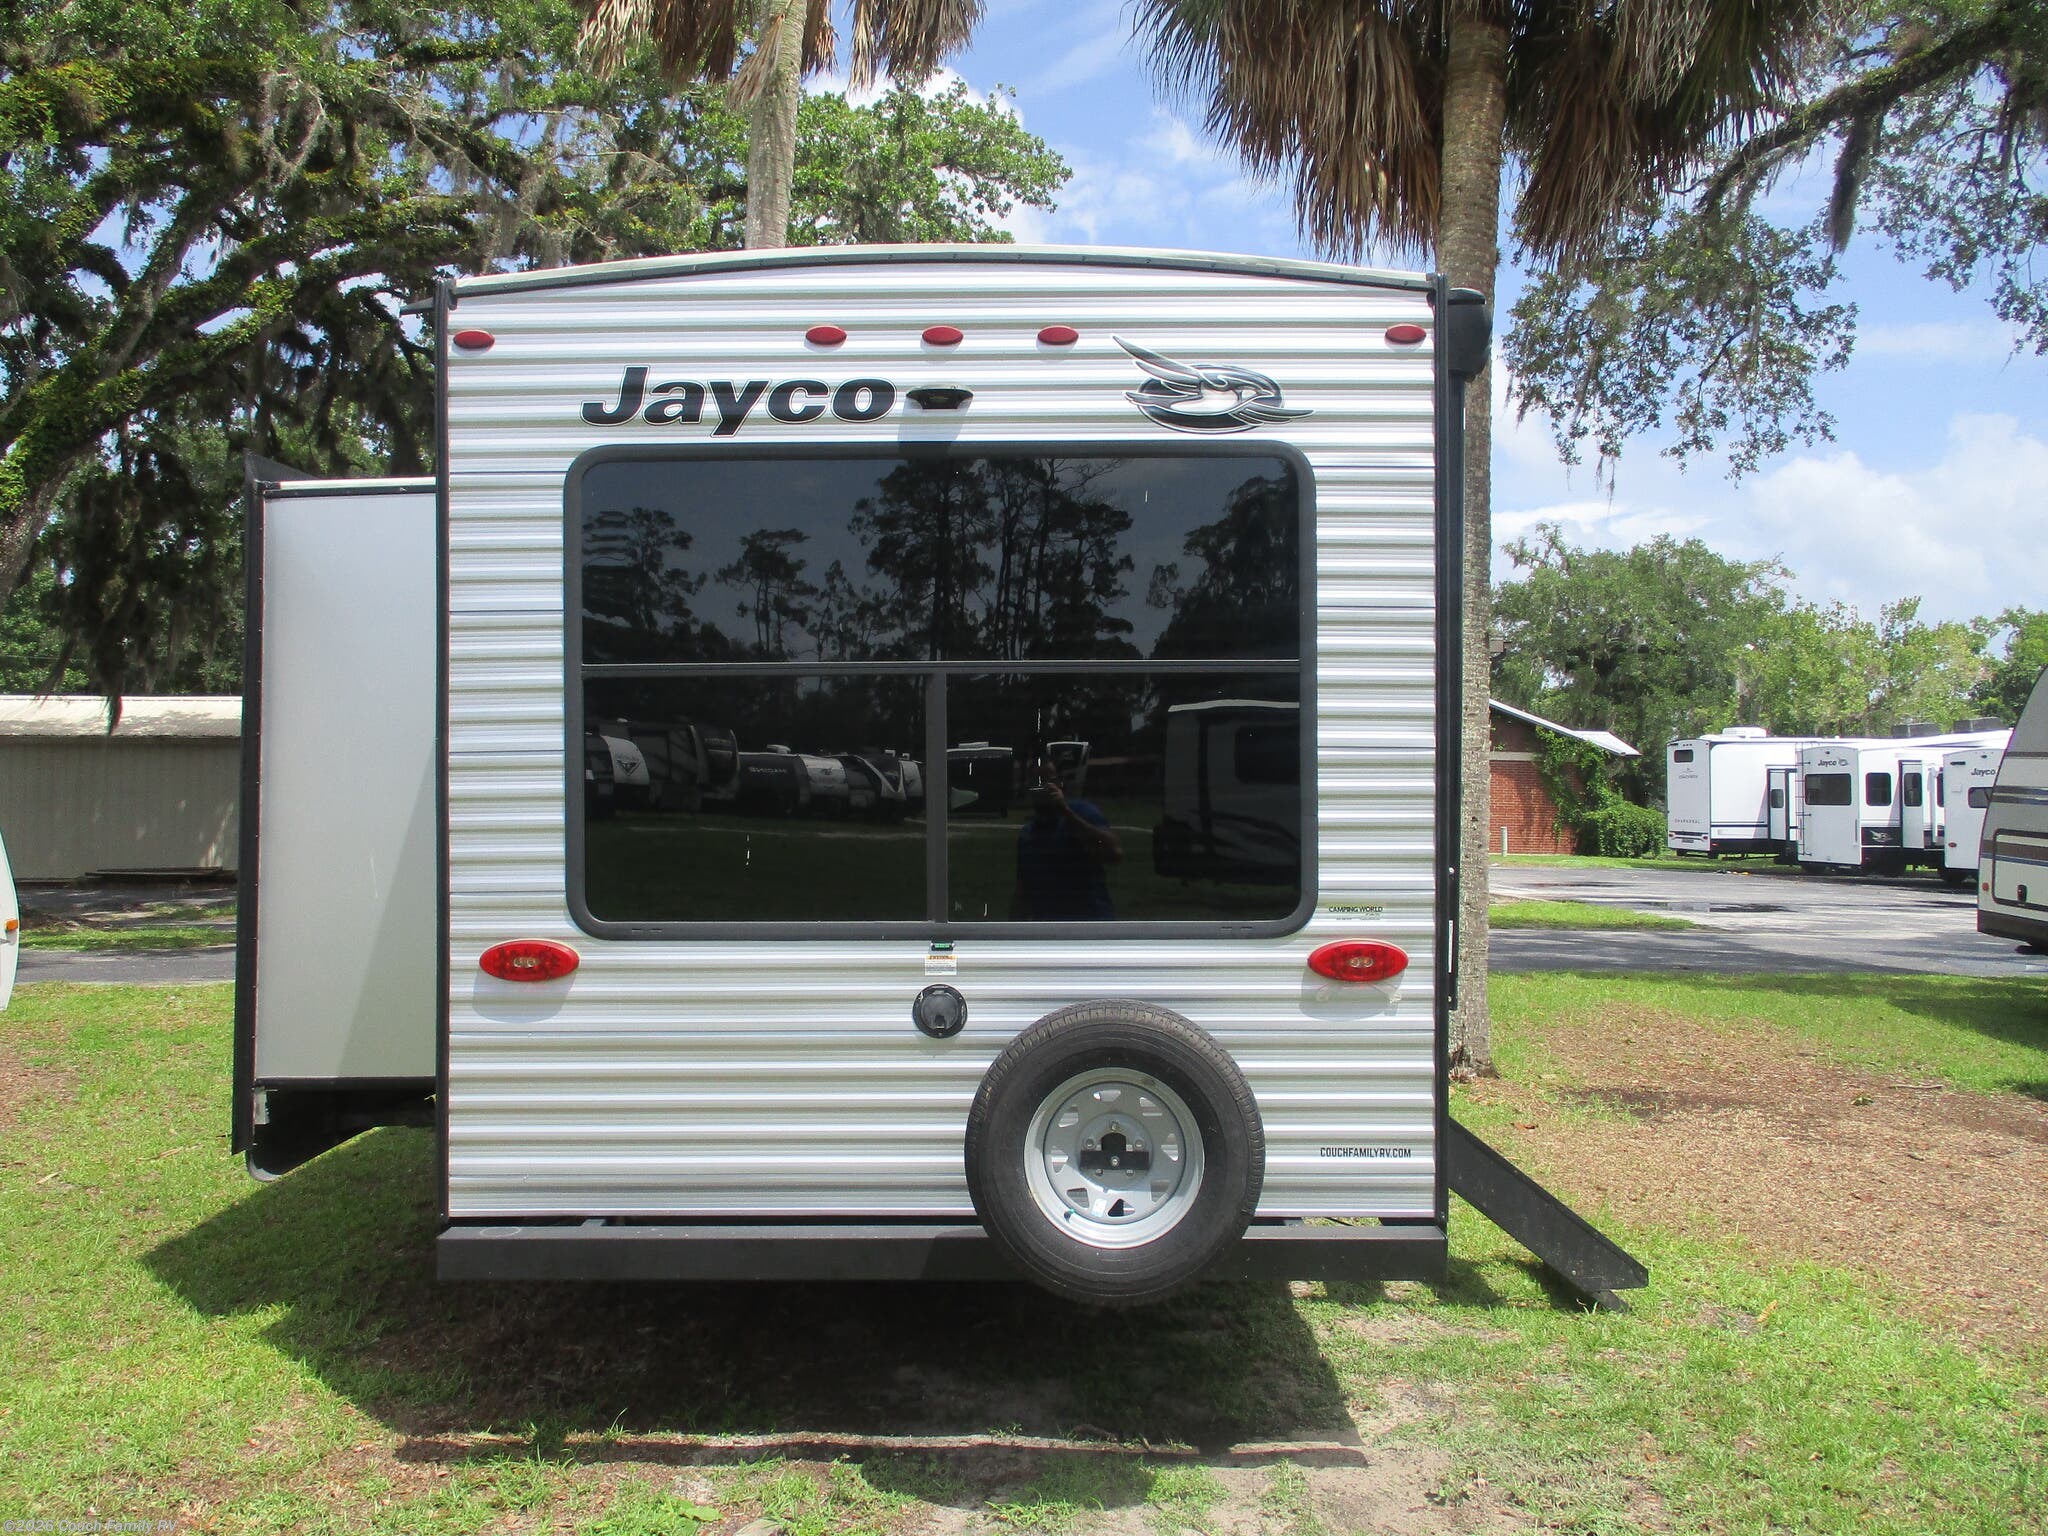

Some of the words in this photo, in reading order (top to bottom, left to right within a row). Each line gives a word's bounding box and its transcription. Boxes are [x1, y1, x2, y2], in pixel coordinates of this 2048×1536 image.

[580, 365, 897, 437] Jayco
[1817, 759, 1837, 768] Jayco
[1970, 767, 1996, 777] Jayco
[1320, 1147, 1411, 1158] COUCHFAMILYRV.COM
